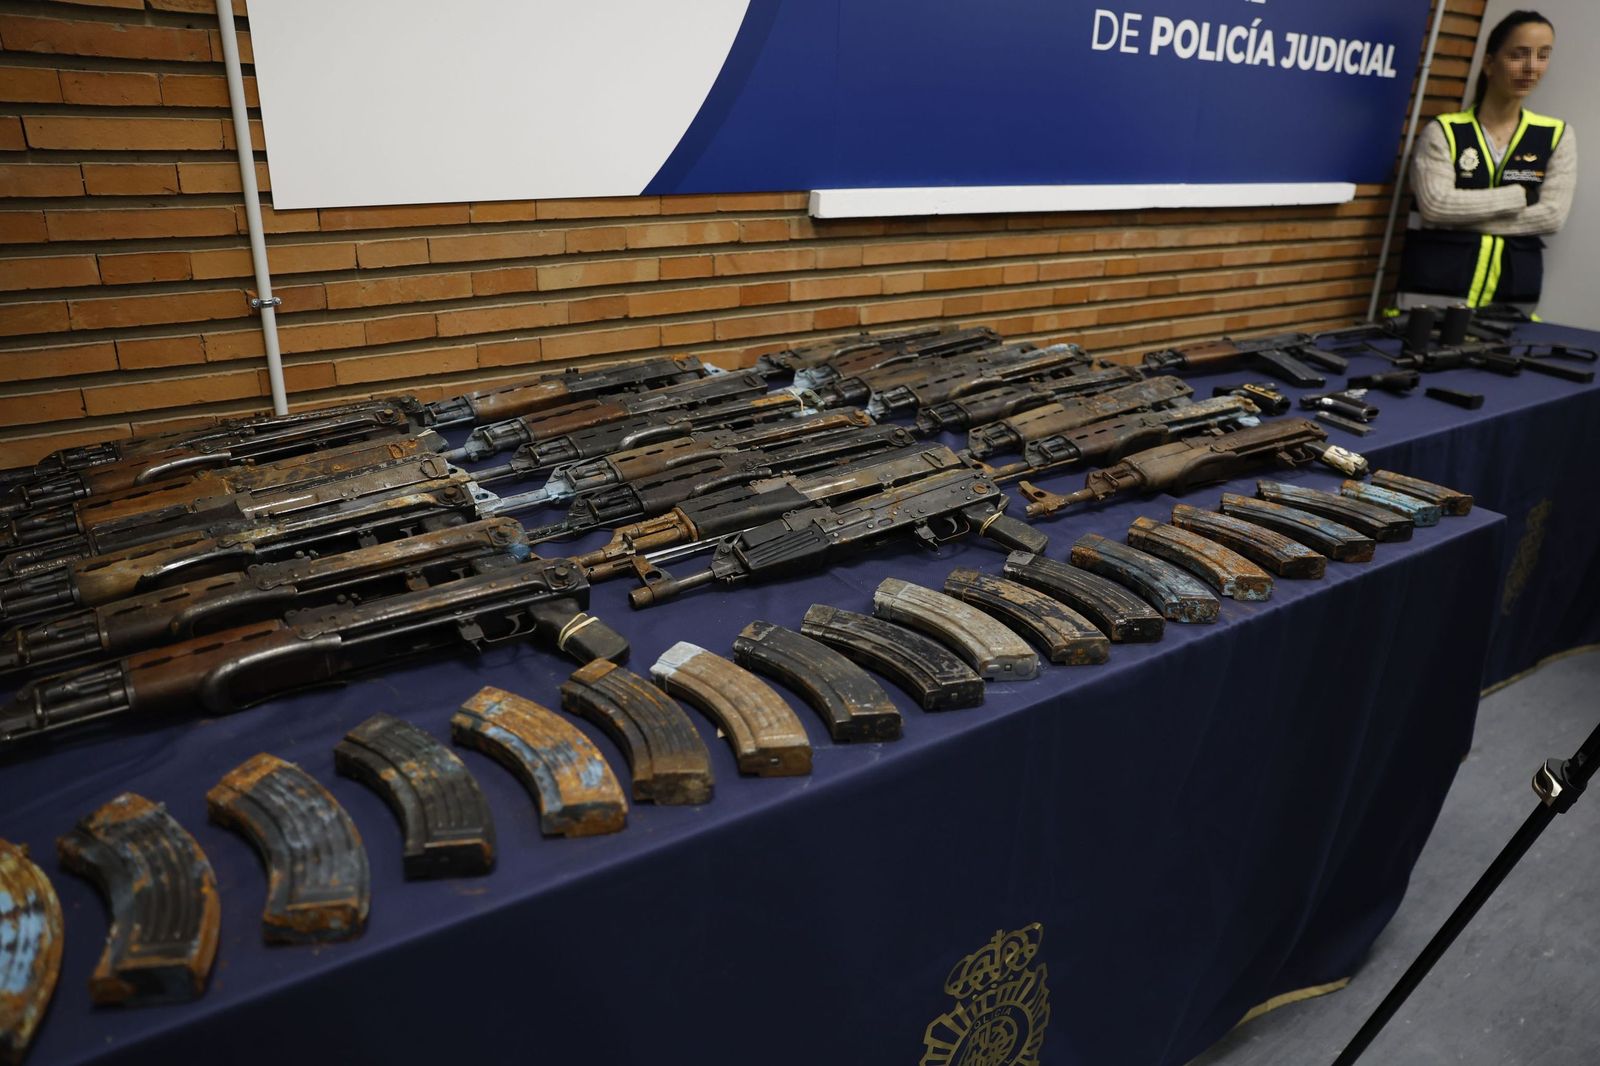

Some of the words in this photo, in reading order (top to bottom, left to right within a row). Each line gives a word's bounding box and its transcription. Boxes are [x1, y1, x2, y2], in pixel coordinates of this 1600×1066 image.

[1091, 8, 1143, 54] DE
[1149, 16, 1276, 67] POLICÍA
[1280, 32, 1396, 78] JUDICIAL
